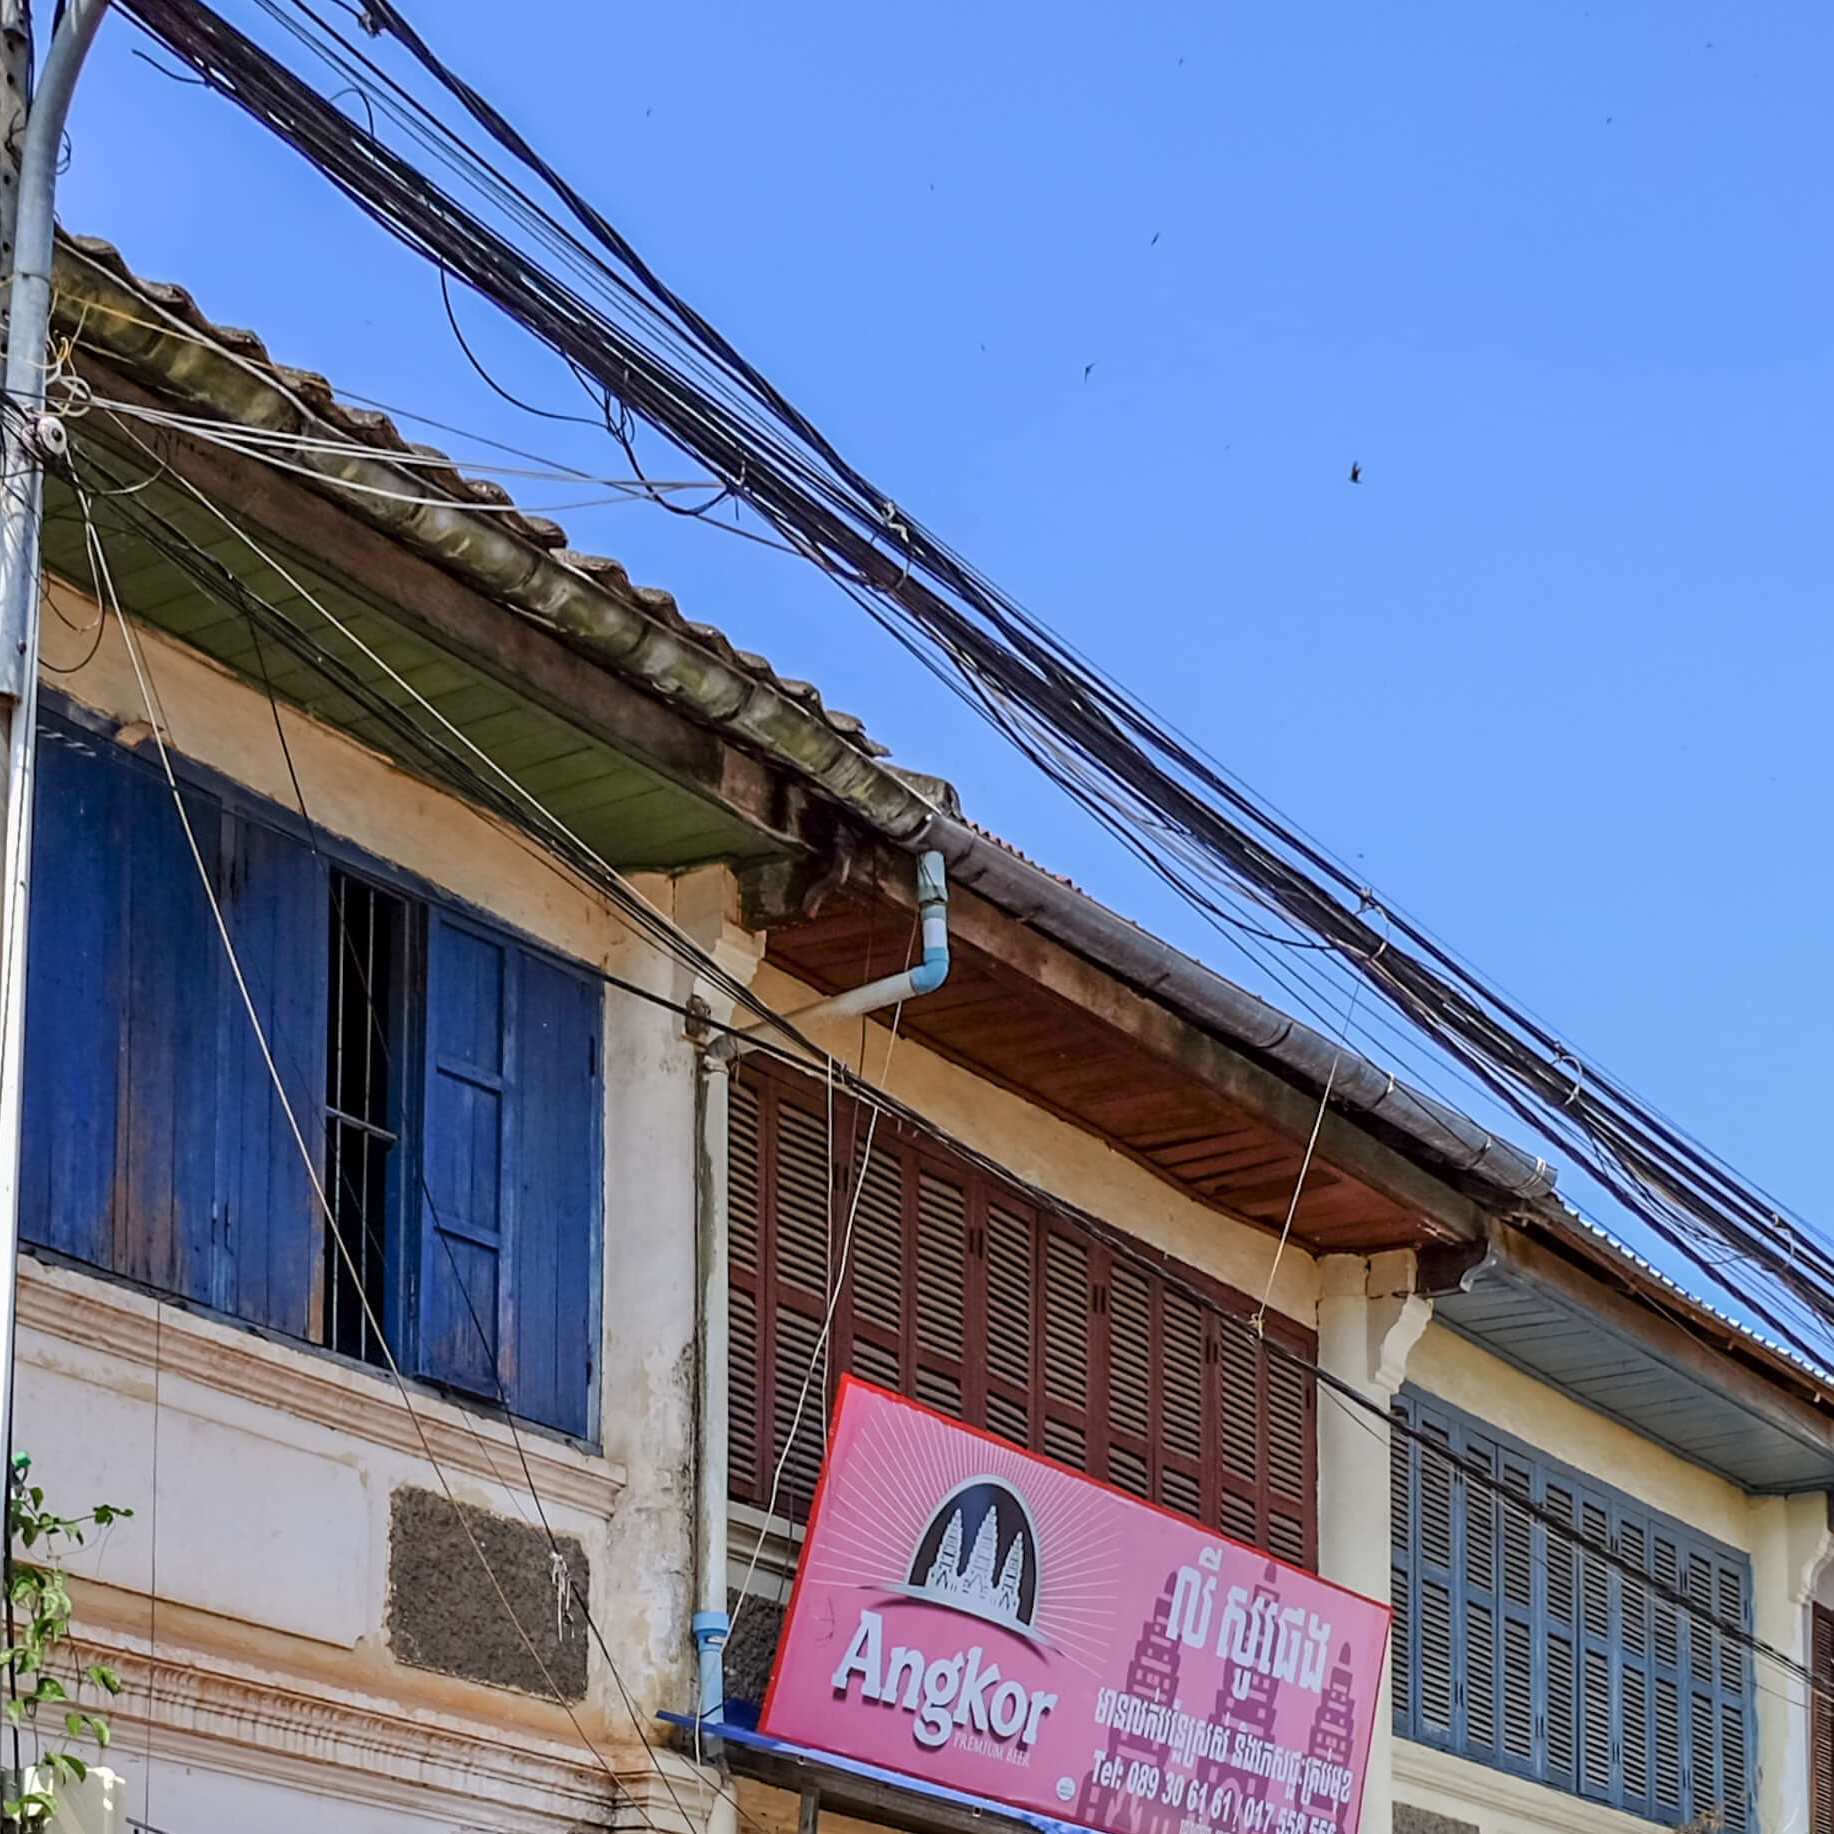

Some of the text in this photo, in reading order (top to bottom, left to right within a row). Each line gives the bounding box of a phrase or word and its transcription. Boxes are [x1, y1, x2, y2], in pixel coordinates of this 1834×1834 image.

[831, 1609, 1058, 1746] Angkor
[1092, 1749, 1122, 1787] Tel:
[1126, 1760, 1161, 1799] 089
[1162, 1771, 1186, 1807] 30
[1186, 1778, 1208, 1815] 61
[1211, 1785, 1233, 1822] 61
